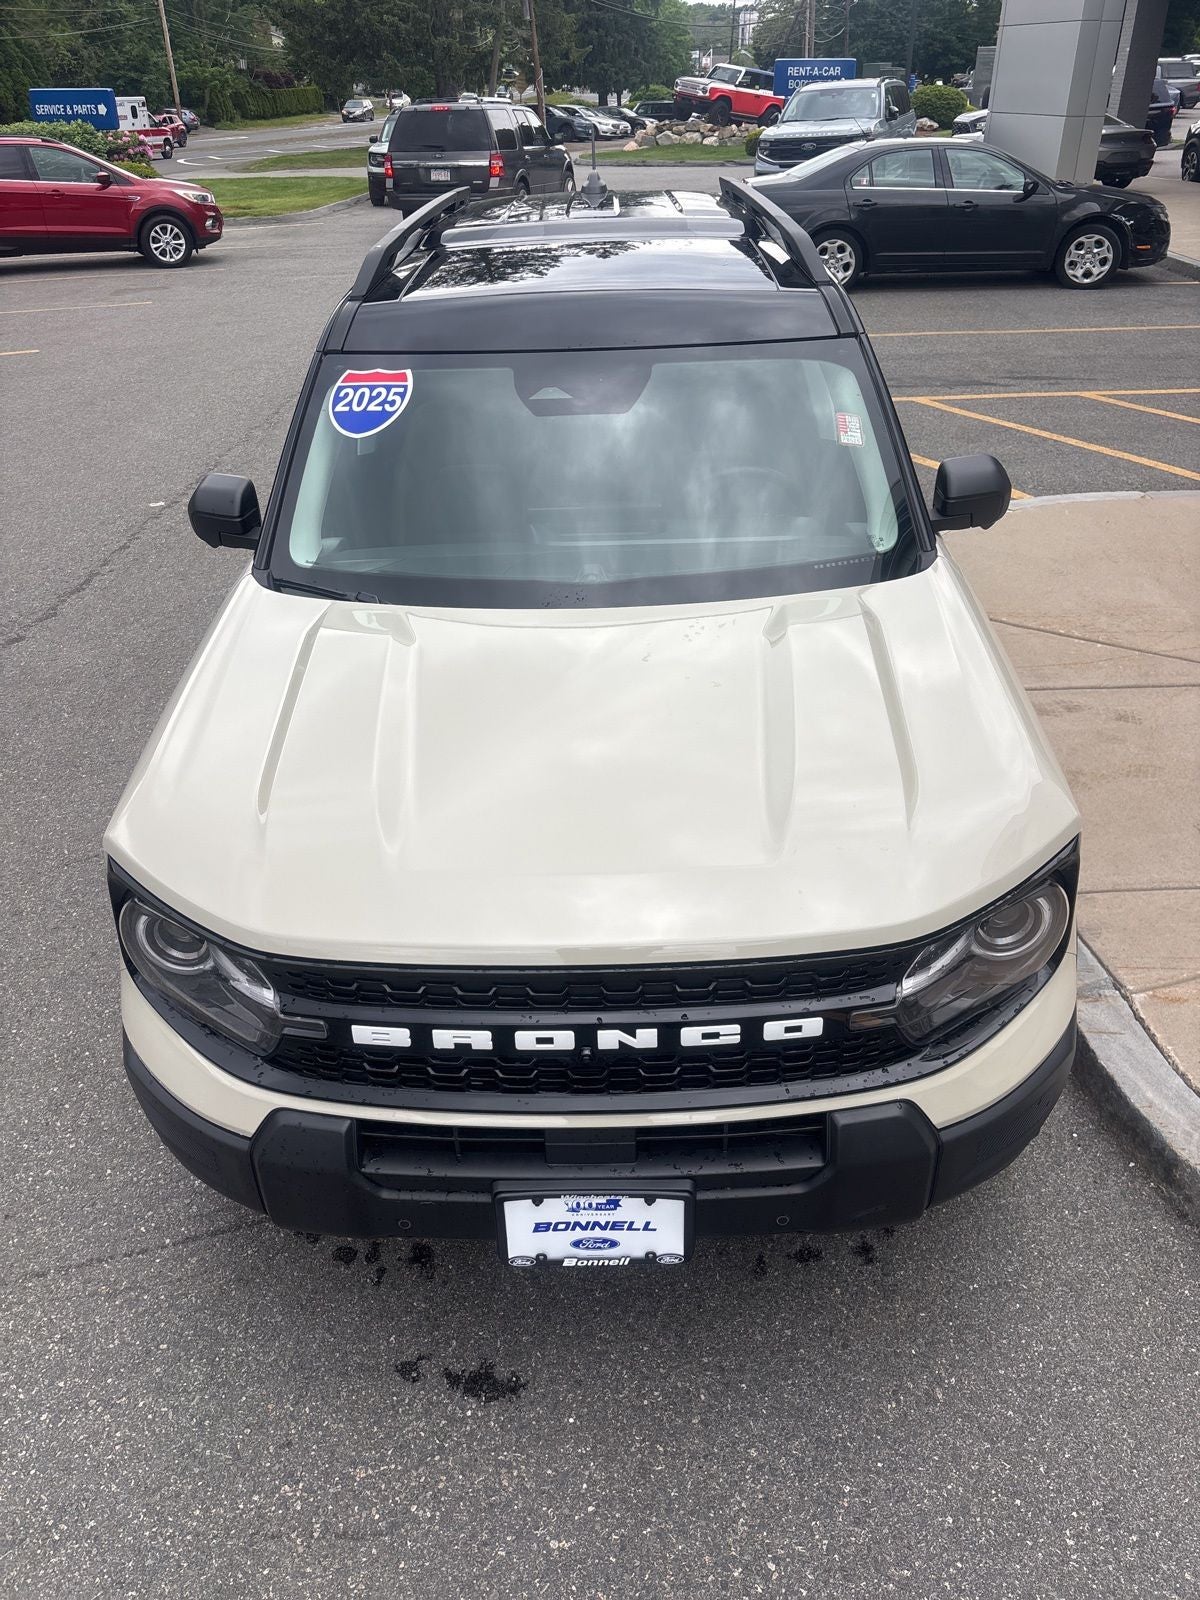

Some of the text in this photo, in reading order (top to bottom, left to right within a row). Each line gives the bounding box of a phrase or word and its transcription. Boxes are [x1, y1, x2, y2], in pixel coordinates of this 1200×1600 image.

[787, 66, 841, 76] RENT-A-CAR
[788, 79, 811, 89] BOD
[35, 104, 97, 115] SERVICE & PARTS
[334, 387, 405, 412] 2025
[351, 1016, 824, 1051] BRONCO
[564, 1200, 597, 1212] 100
[532, 1220, 657, 1233] BONNELL
[578, 1238, 612, 1249] Ford
[511, 1257, 534, 1266] Ford
[562, 1256, 631, 1267] Bonnell
[658, 1255, 682, 1264] Ford
